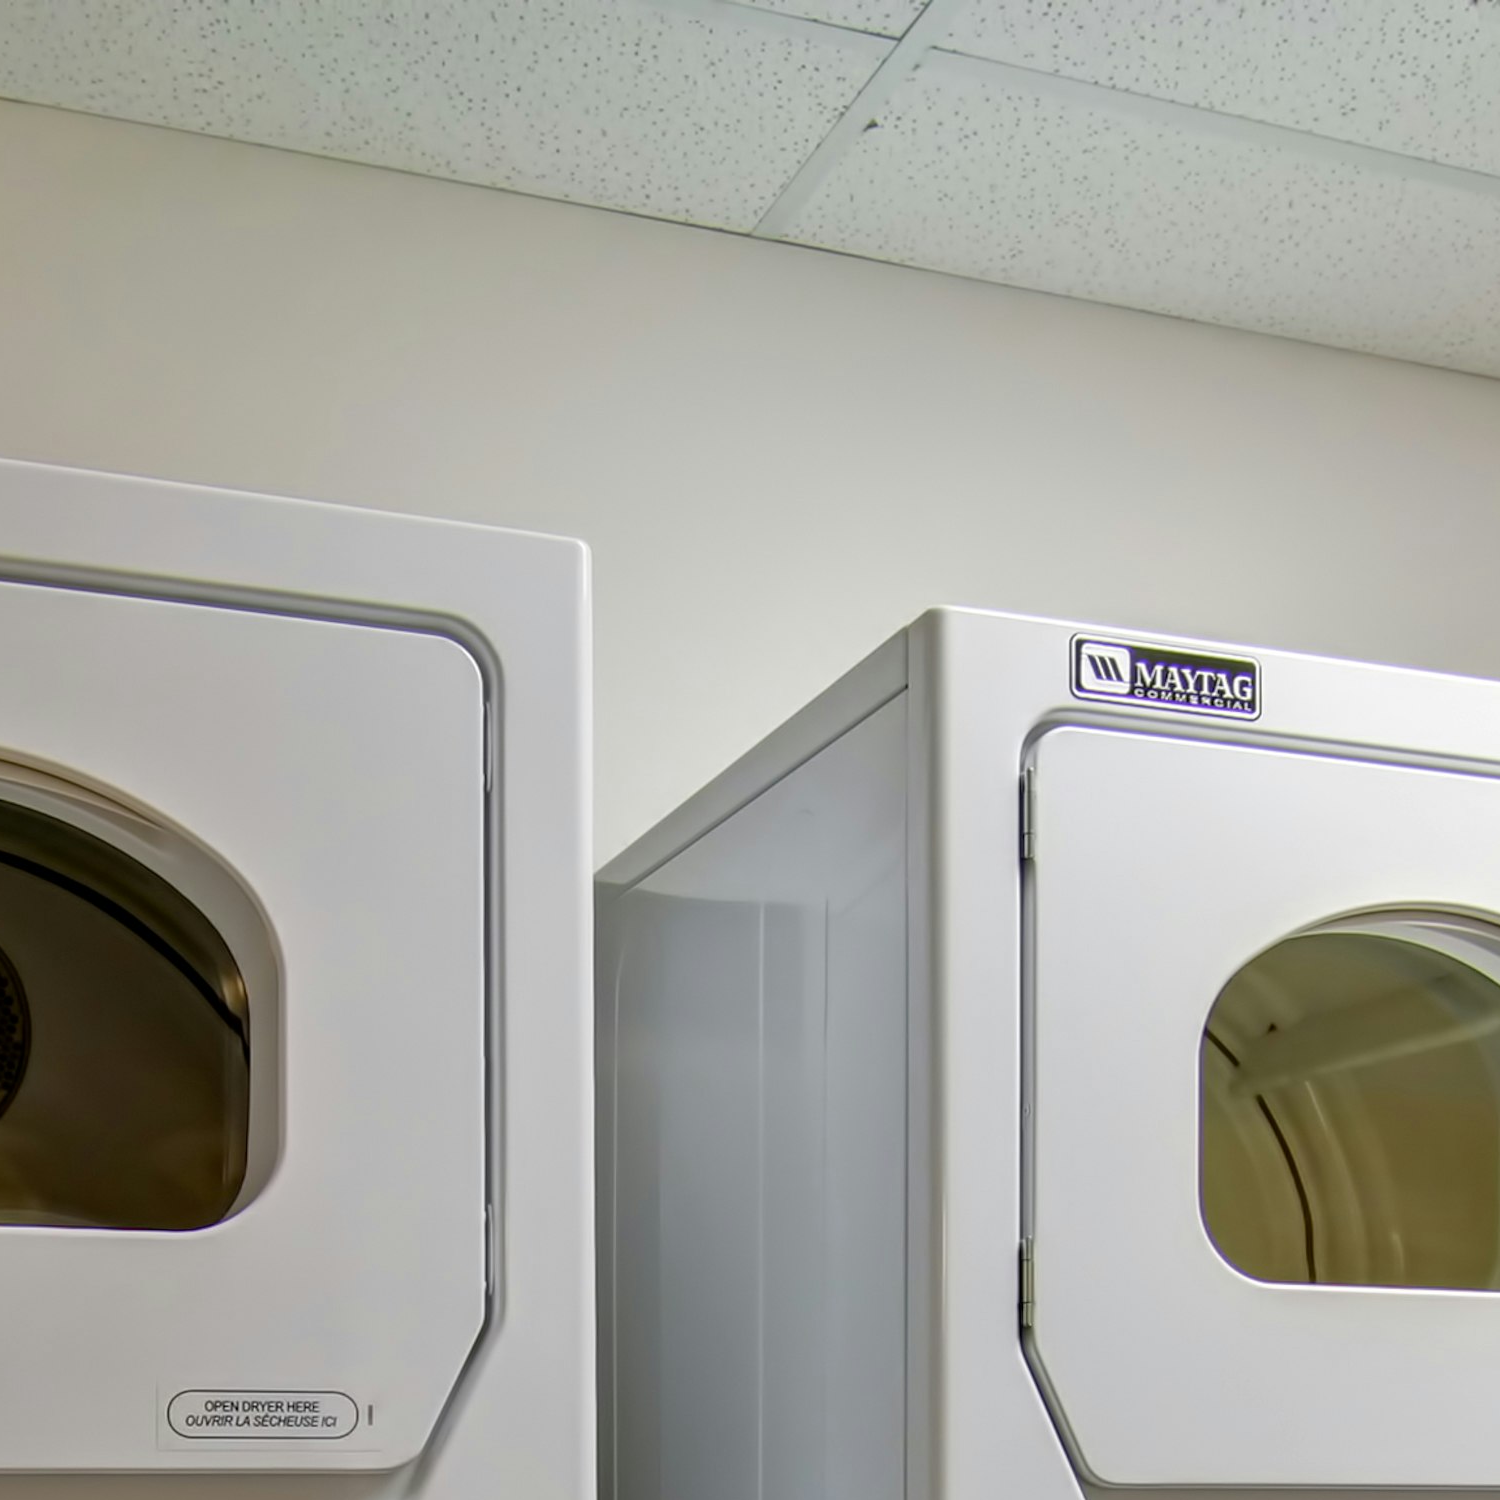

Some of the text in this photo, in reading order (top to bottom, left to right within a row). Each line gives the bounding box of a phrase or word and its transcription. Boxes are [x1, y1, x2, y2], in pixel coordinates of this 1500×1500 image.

[1134, 662, 1253, 700] MAYTAG
[1134, 688, 1252, 712] COMMERCIAL
[205, 1400, 320, 1413] OPEN DRYER HERE
[186, 1415, 233, 1427] OUVRIR
[236, 1416, 251, 1426] LA
[321, 1416, 337, 1427] ICI
